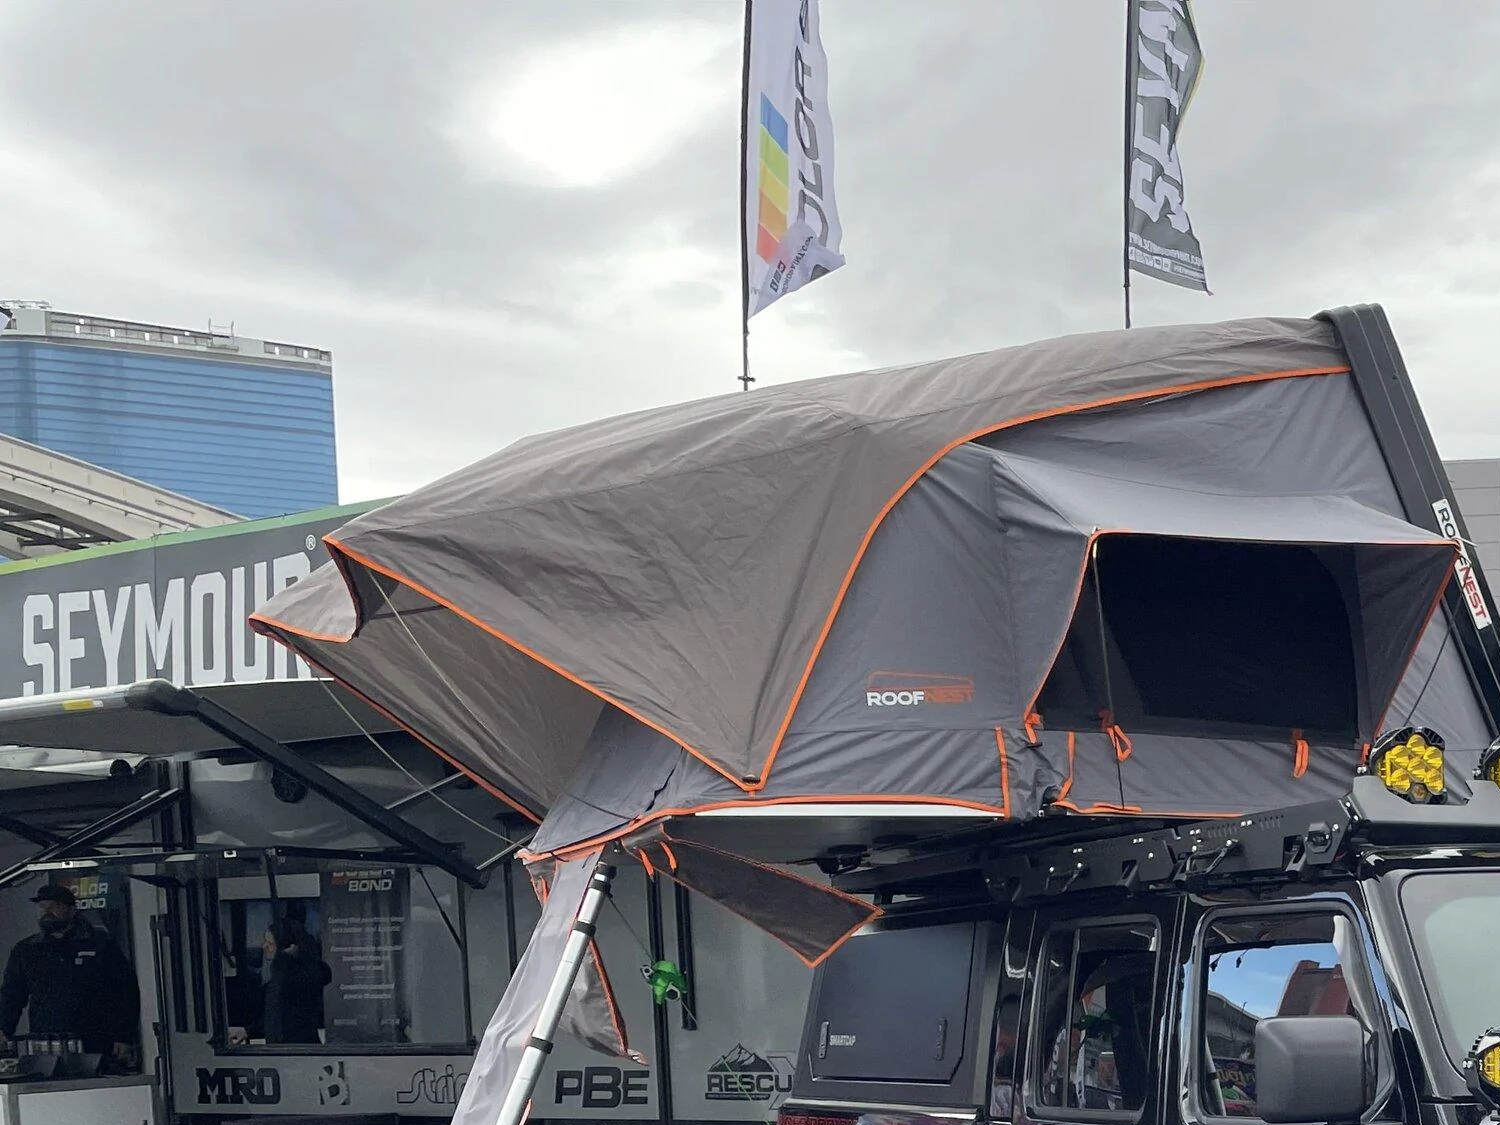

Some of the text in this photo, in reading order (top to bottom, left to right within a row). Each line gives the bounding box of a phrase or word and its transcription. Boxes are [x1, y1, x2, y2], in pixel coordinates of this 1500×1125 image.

[348, 879, 392, 892] BOND
[196, 1067, 281, 1105] MRO
[555, 1065, 650, 1108] PBE
